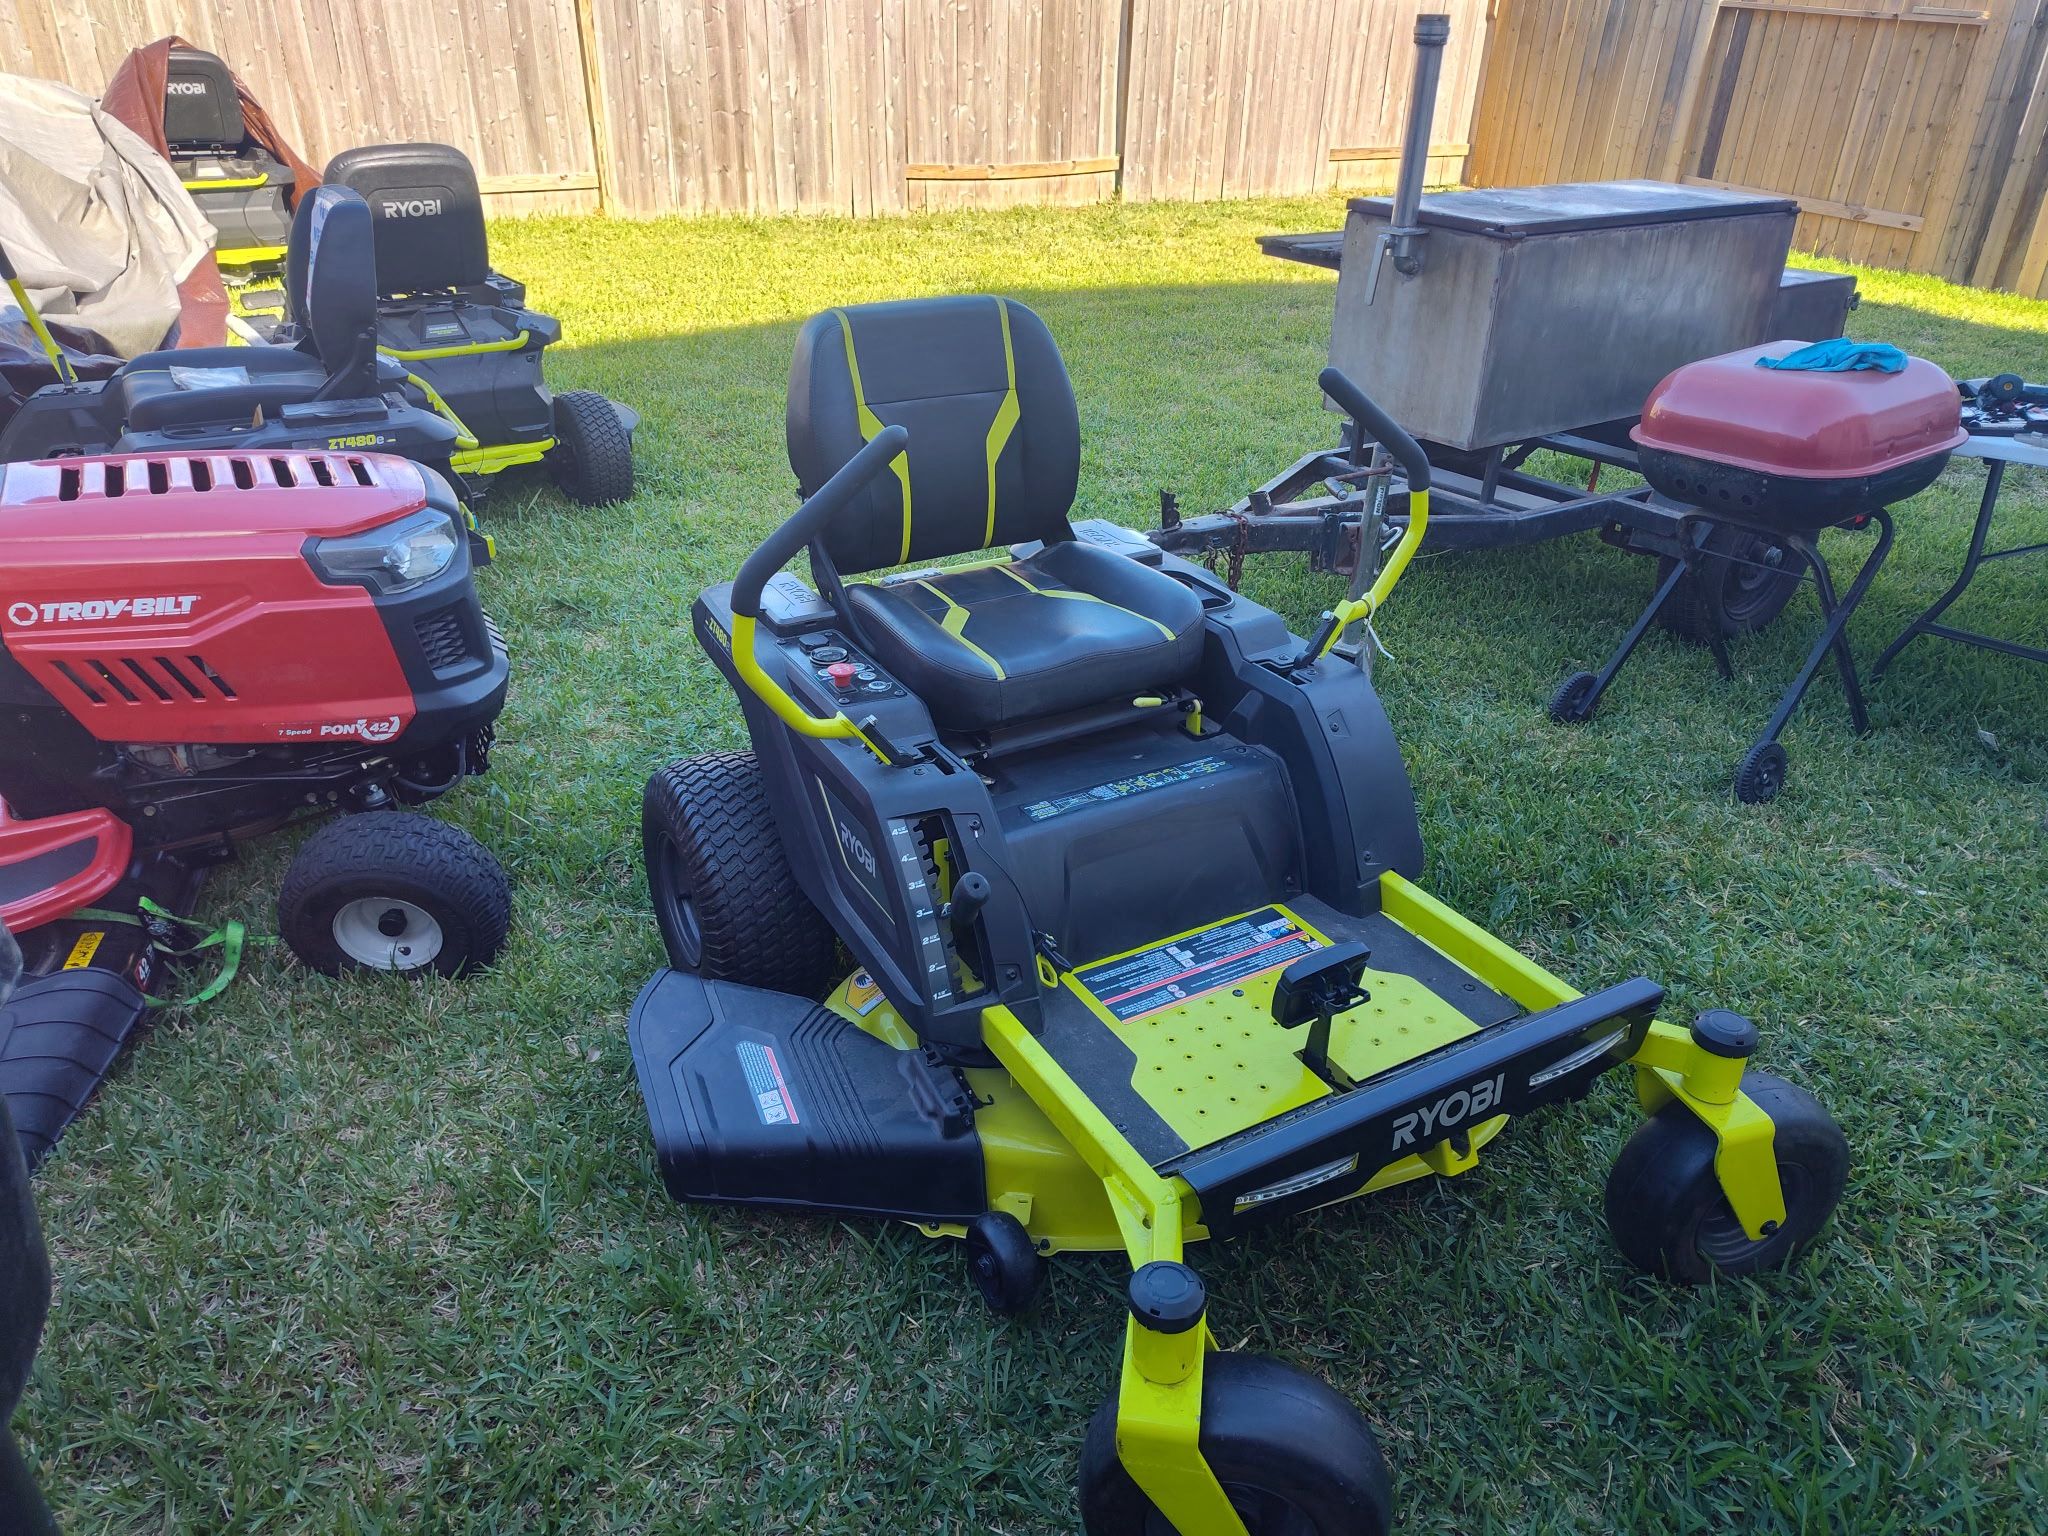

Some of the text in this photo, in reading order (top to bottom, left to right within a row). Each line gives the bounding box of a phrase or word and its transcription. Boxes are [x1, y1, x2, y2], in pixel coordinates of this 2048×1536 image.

[168, 82, 206, 95] RYOBI
[382, 199, 442, 219] RYOBI
[328, 434, 384, 450] ZT480e
[778, 580, 816, 603] RYOBI
[40, 595, 198, 622] TROY-BILT
[286, 728, 312, 736] Speed
[320, 720, 367, 736] PONY
[370, 722, 390, 733] 42
[840, 822, 876, 879] RYOBI
[1391, 1072, 1506, 1152] RYOBI
